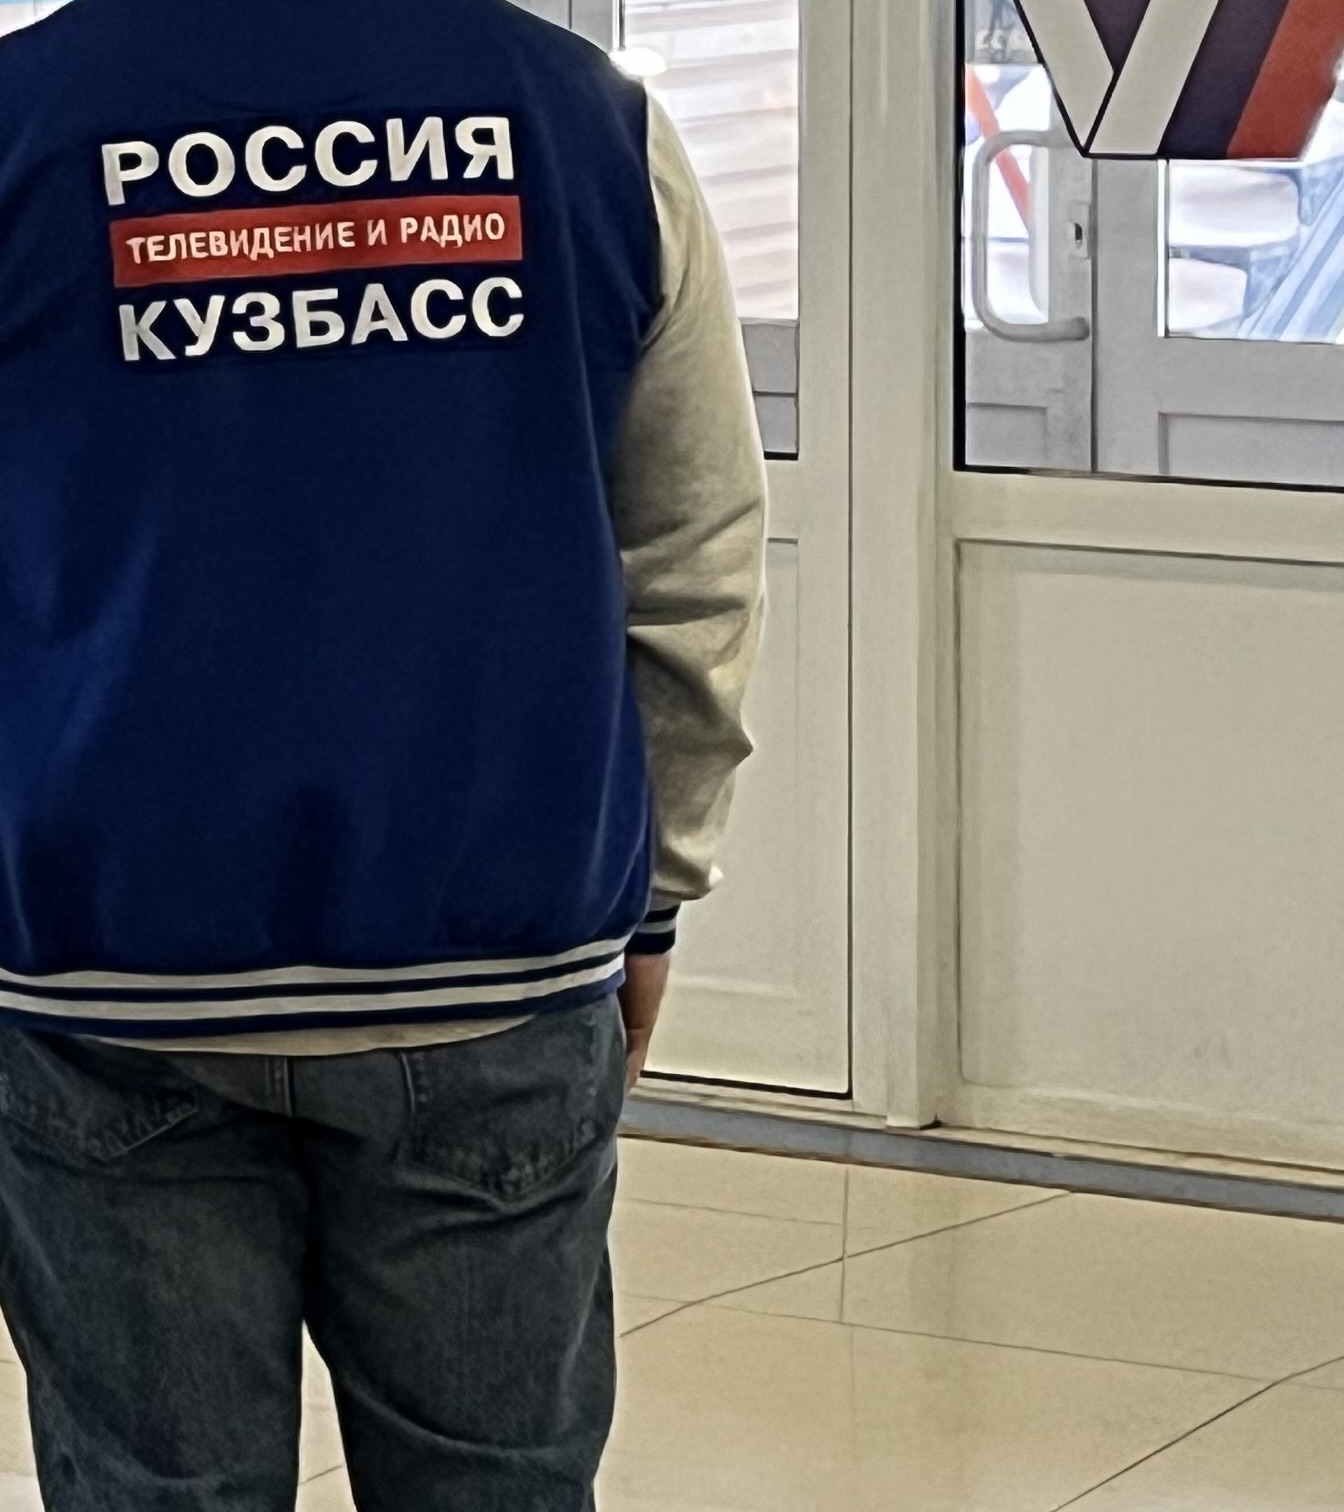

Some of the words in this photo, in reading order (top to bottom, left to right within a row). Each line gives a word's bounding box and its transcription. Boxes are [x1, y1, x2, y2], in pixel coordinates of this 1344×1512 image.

[101, 116, 514, 206] РОССИЯ
[127, 220, 356, 264] ТЕЛЕВИДЕНИЕ
[367, 218, 388, 246] И
[400, 212, 506, 249] РАДИО
[118, 276, 524, 362] КУЗБАСС
